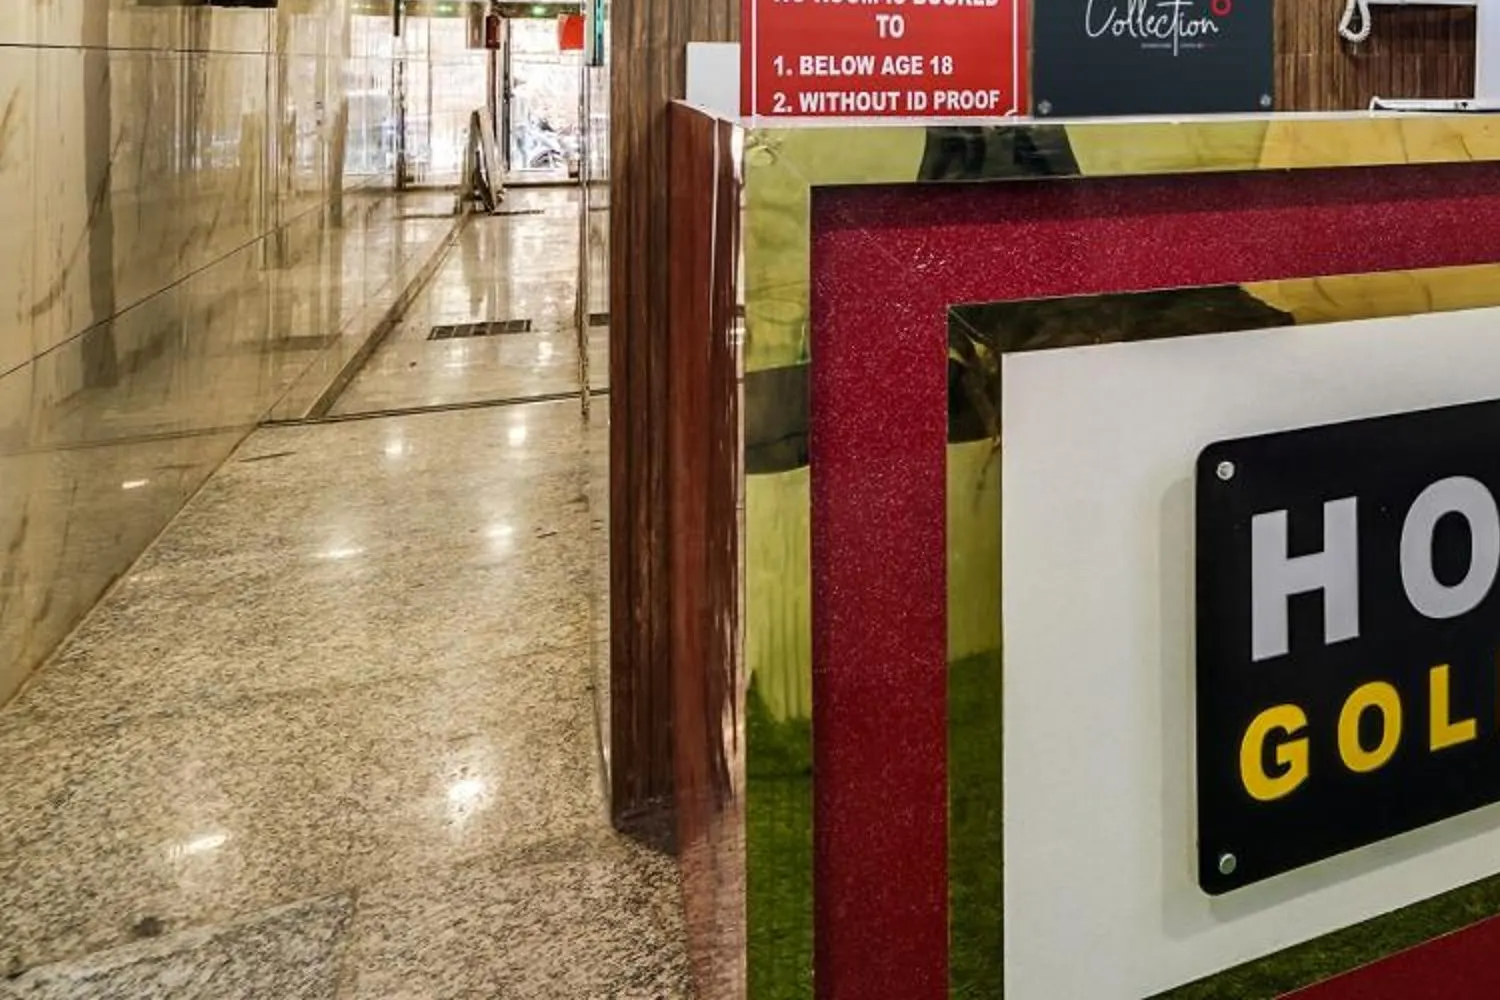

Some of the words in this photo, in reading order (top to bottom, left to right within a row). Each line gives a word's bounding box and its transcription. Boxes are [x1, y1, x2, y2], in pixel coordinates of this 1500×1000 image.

[875, 14, 905, 38] TO
[773, 55, 793, 76] 1.
[800, 55, 875, 76] BELOW
[880, 55, 923, 75] AGE
[929, 55, 953, 75] 18
[773, 93, 793, 113] 2.
[800, 91, 903, 113] WITHOUT
[907, 91, 927, 111] ID
[933, 90, 1000, 110] PROOF
